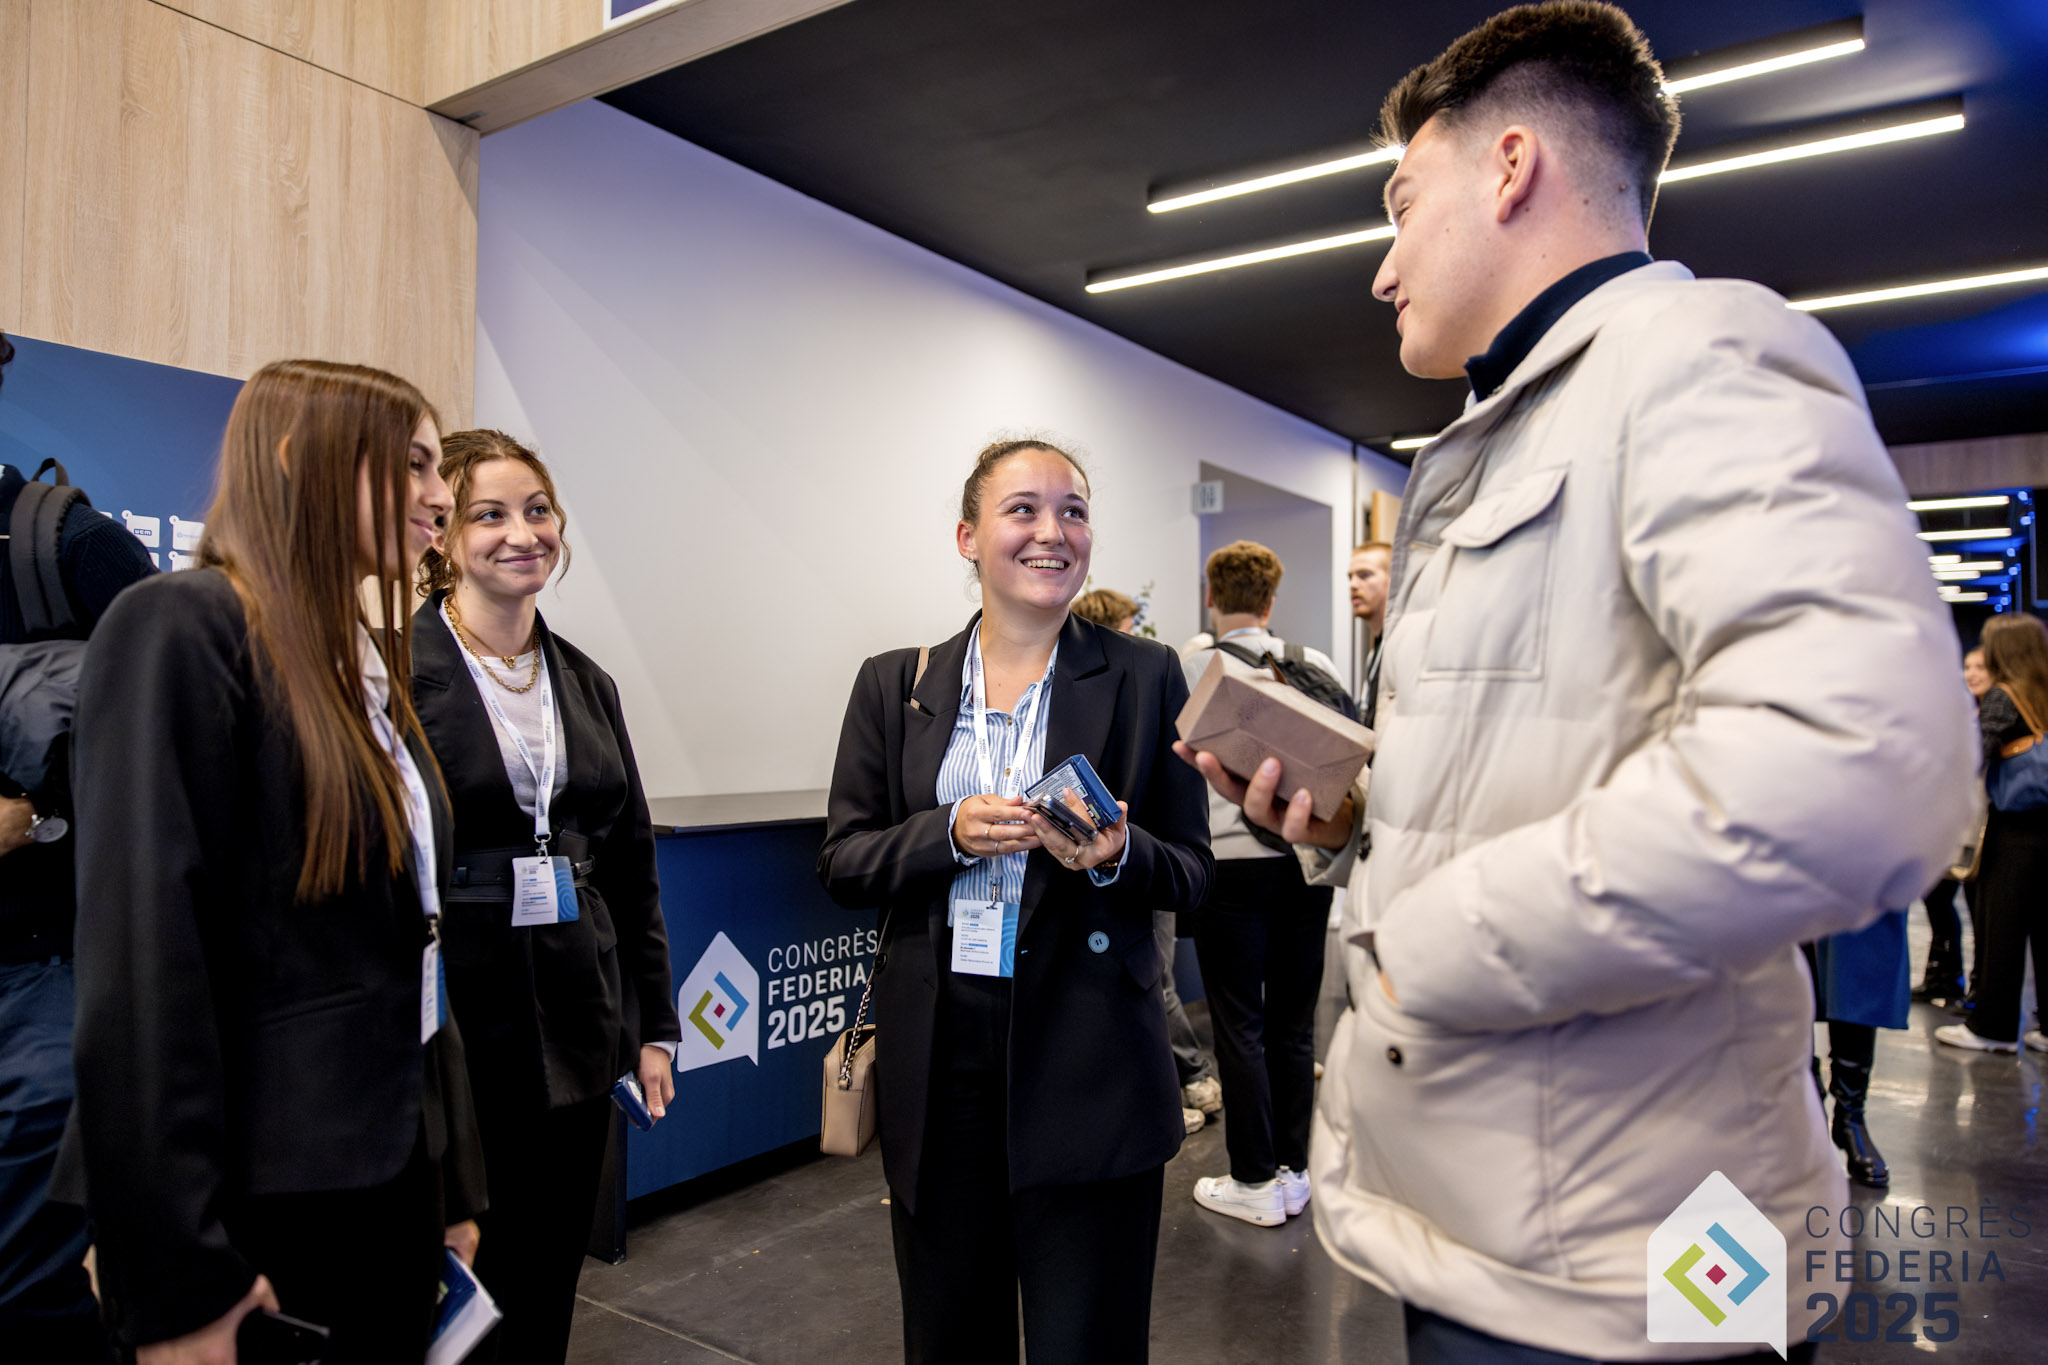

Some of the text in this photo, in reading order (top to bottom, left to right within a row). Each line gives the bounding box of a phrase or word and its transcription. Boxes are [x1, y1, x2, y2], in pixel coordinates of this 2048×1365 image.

[768, 927, 878, 973] CONGRÈS
[768, 962, 867, 1006] FEDERIA
[767, 995, 846, 1050] 2025
